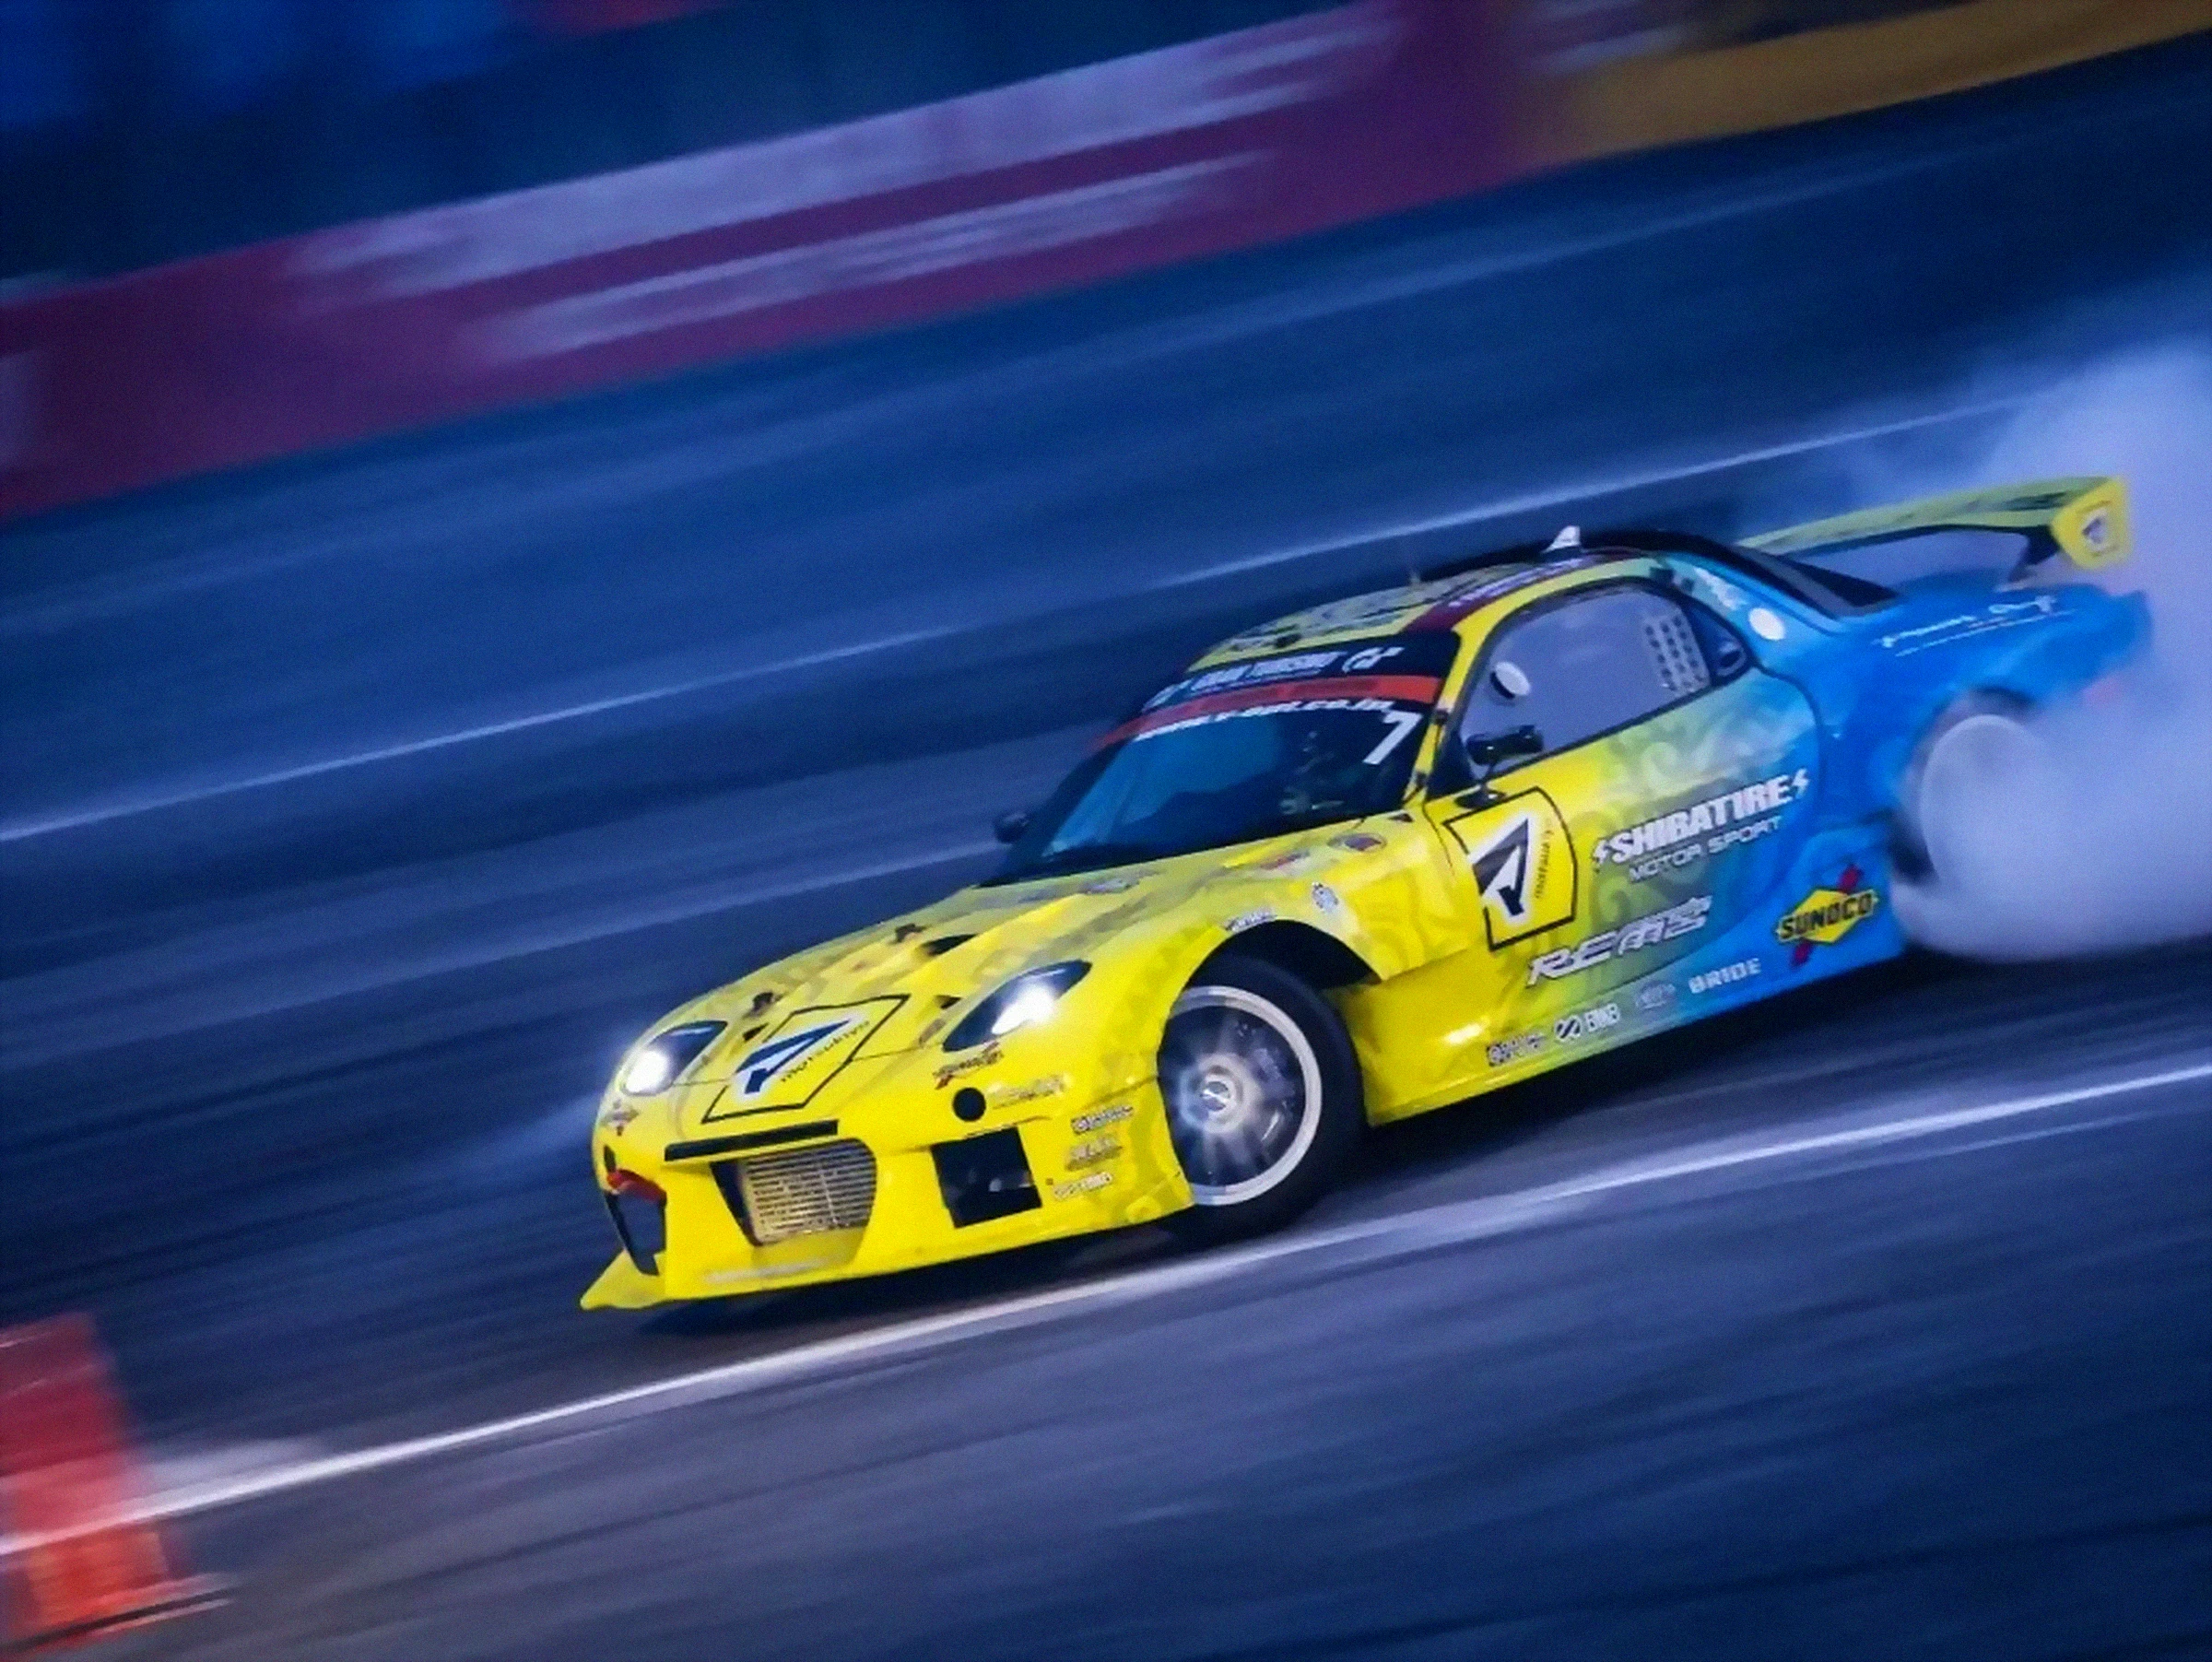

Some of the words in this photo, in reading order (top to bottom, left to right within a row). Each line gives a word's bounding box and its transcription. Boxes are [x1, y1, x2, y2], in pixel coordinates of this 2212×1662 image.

[1363, 710, 1422, 765] 7
[1610, 774, 1793, 864] SHIBATIRE
[1630, 843, 1701, 883] MOTOR
[1708, 815, 1783, 854] SPORT
[1779, 891, 1874, 941] SUNOCO
[1688, 958, 1761, 995] BRIDE
